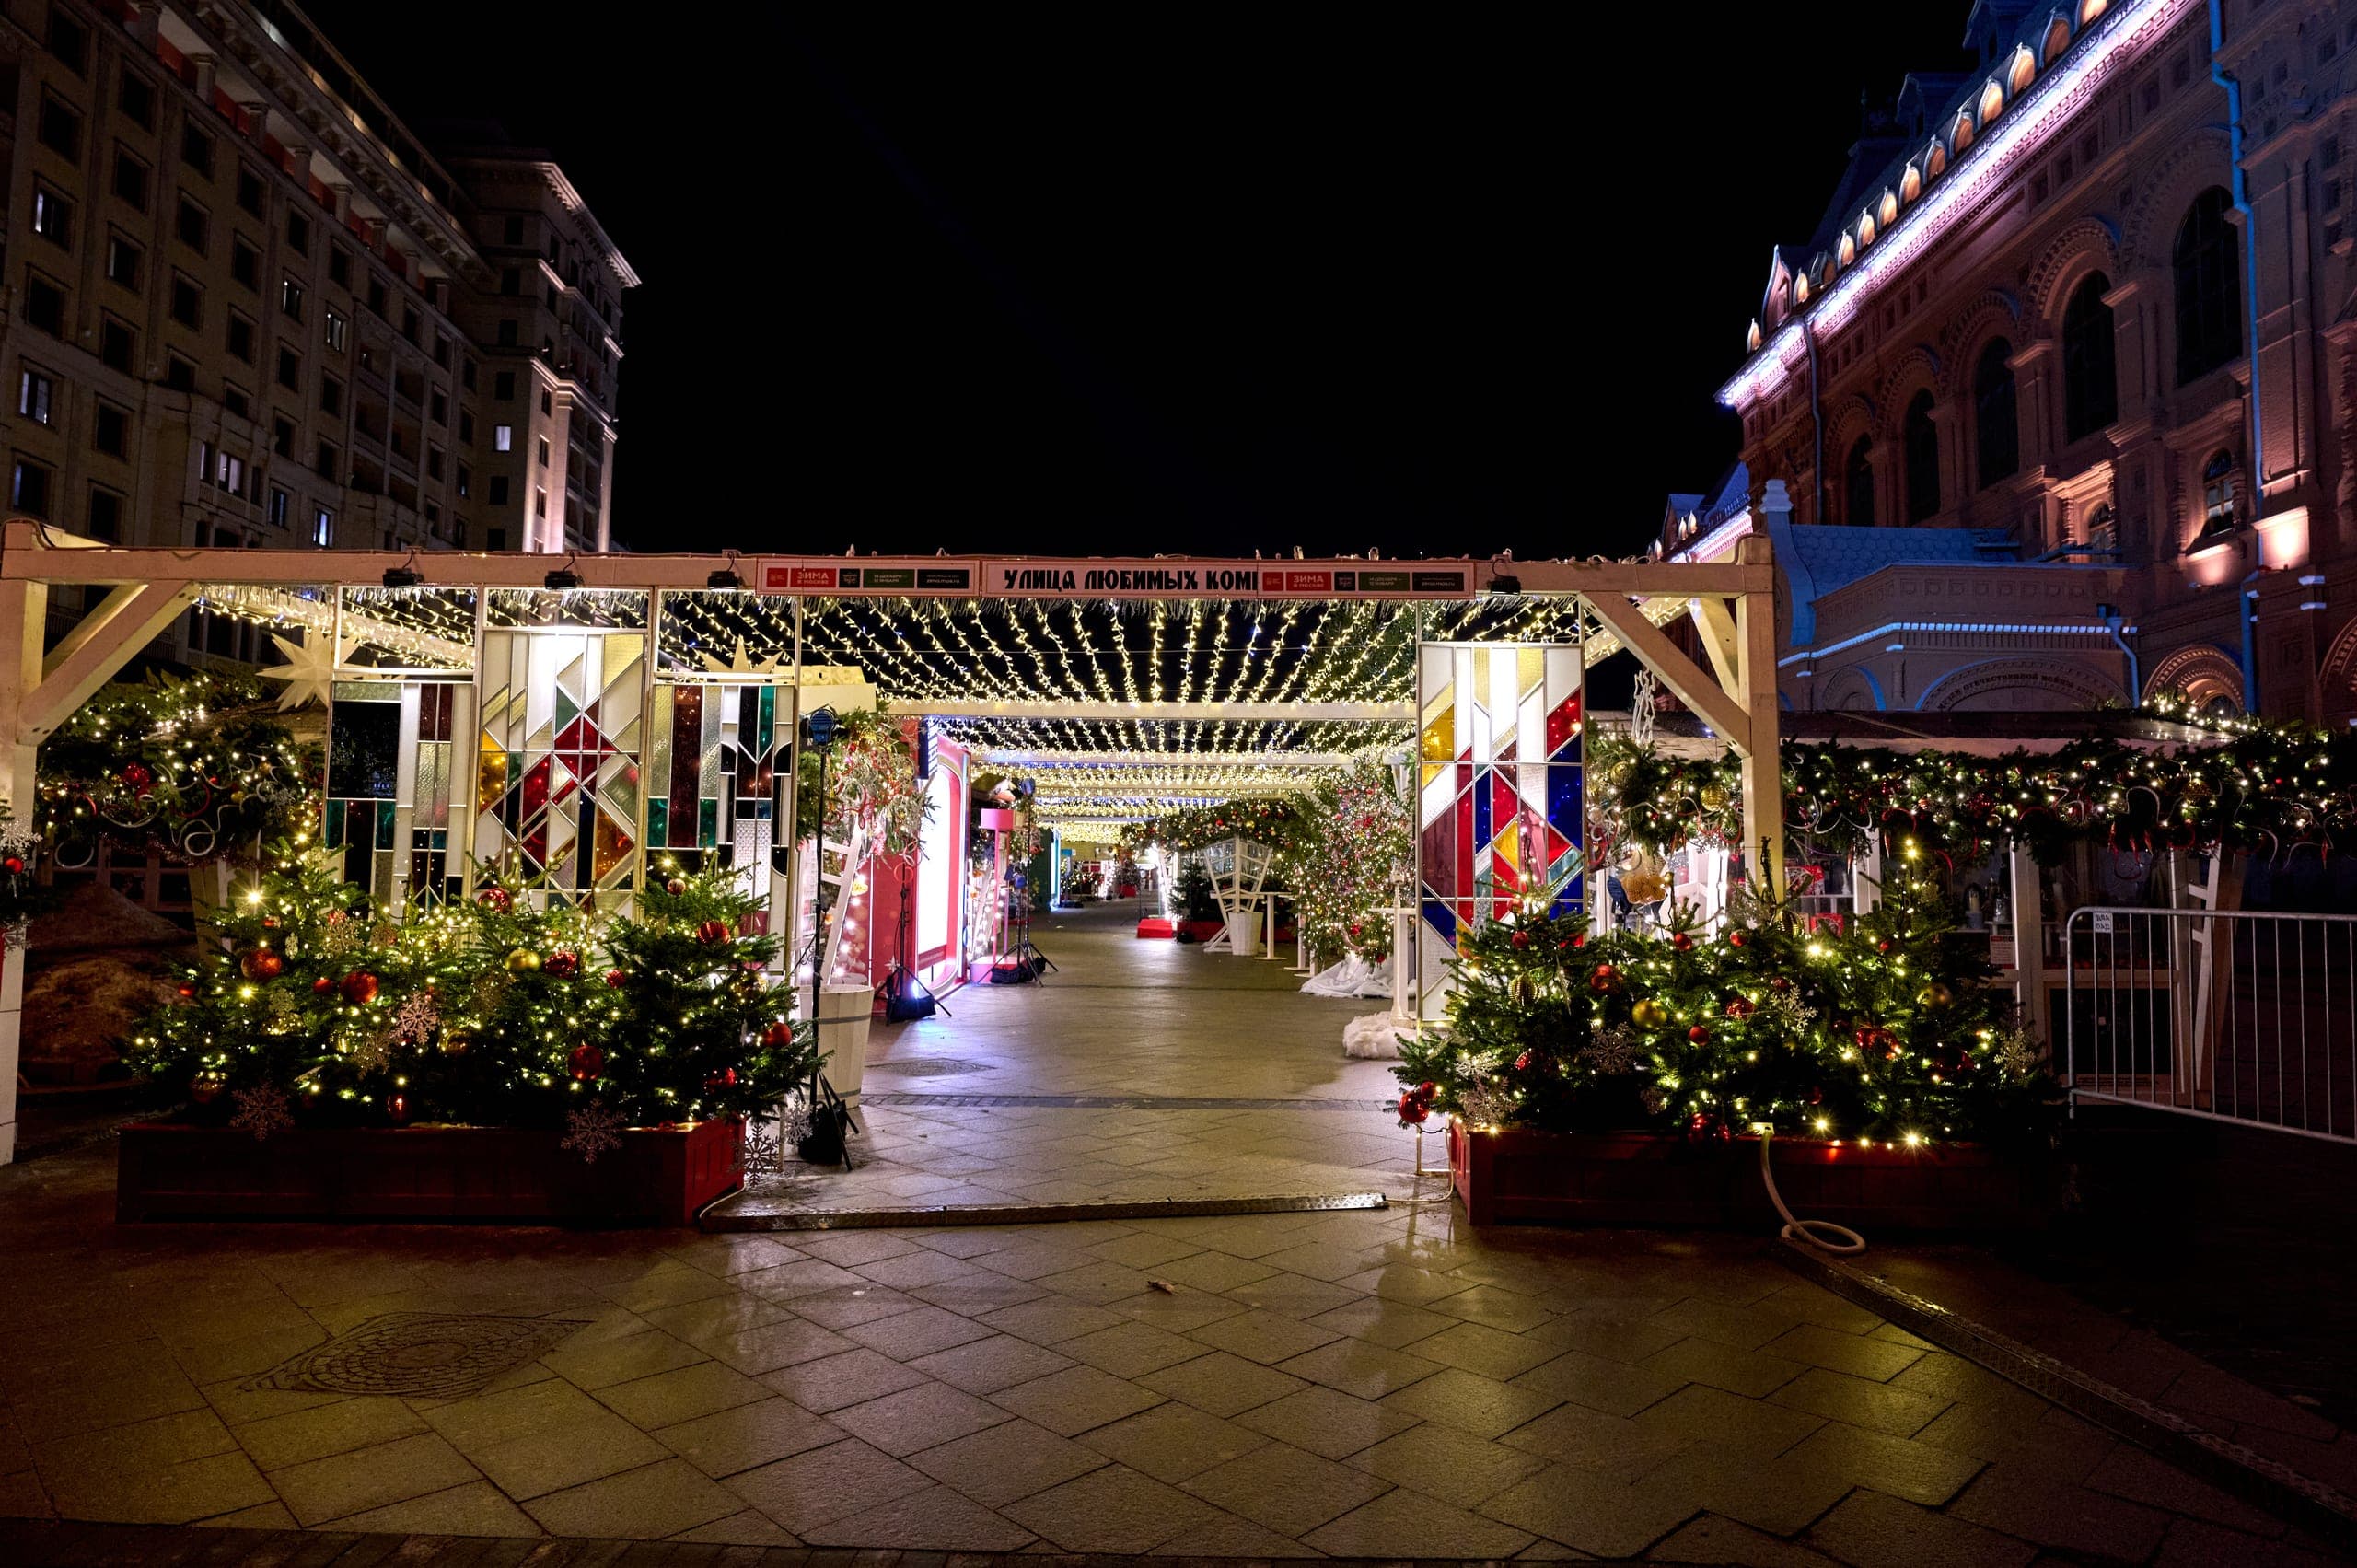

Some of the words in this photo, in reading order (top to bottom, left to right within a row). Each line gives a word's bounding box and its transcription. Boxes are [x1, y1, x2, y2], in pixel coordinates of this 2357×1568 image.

[796, 571, 830, 580] ЗИМА
[1293, 575, 1324, 583] ЗИМА
[1004, 569, 1076, 592] УЛИЦА
[1084, 569, 1199, 590] ЛЮБИМЫХ
